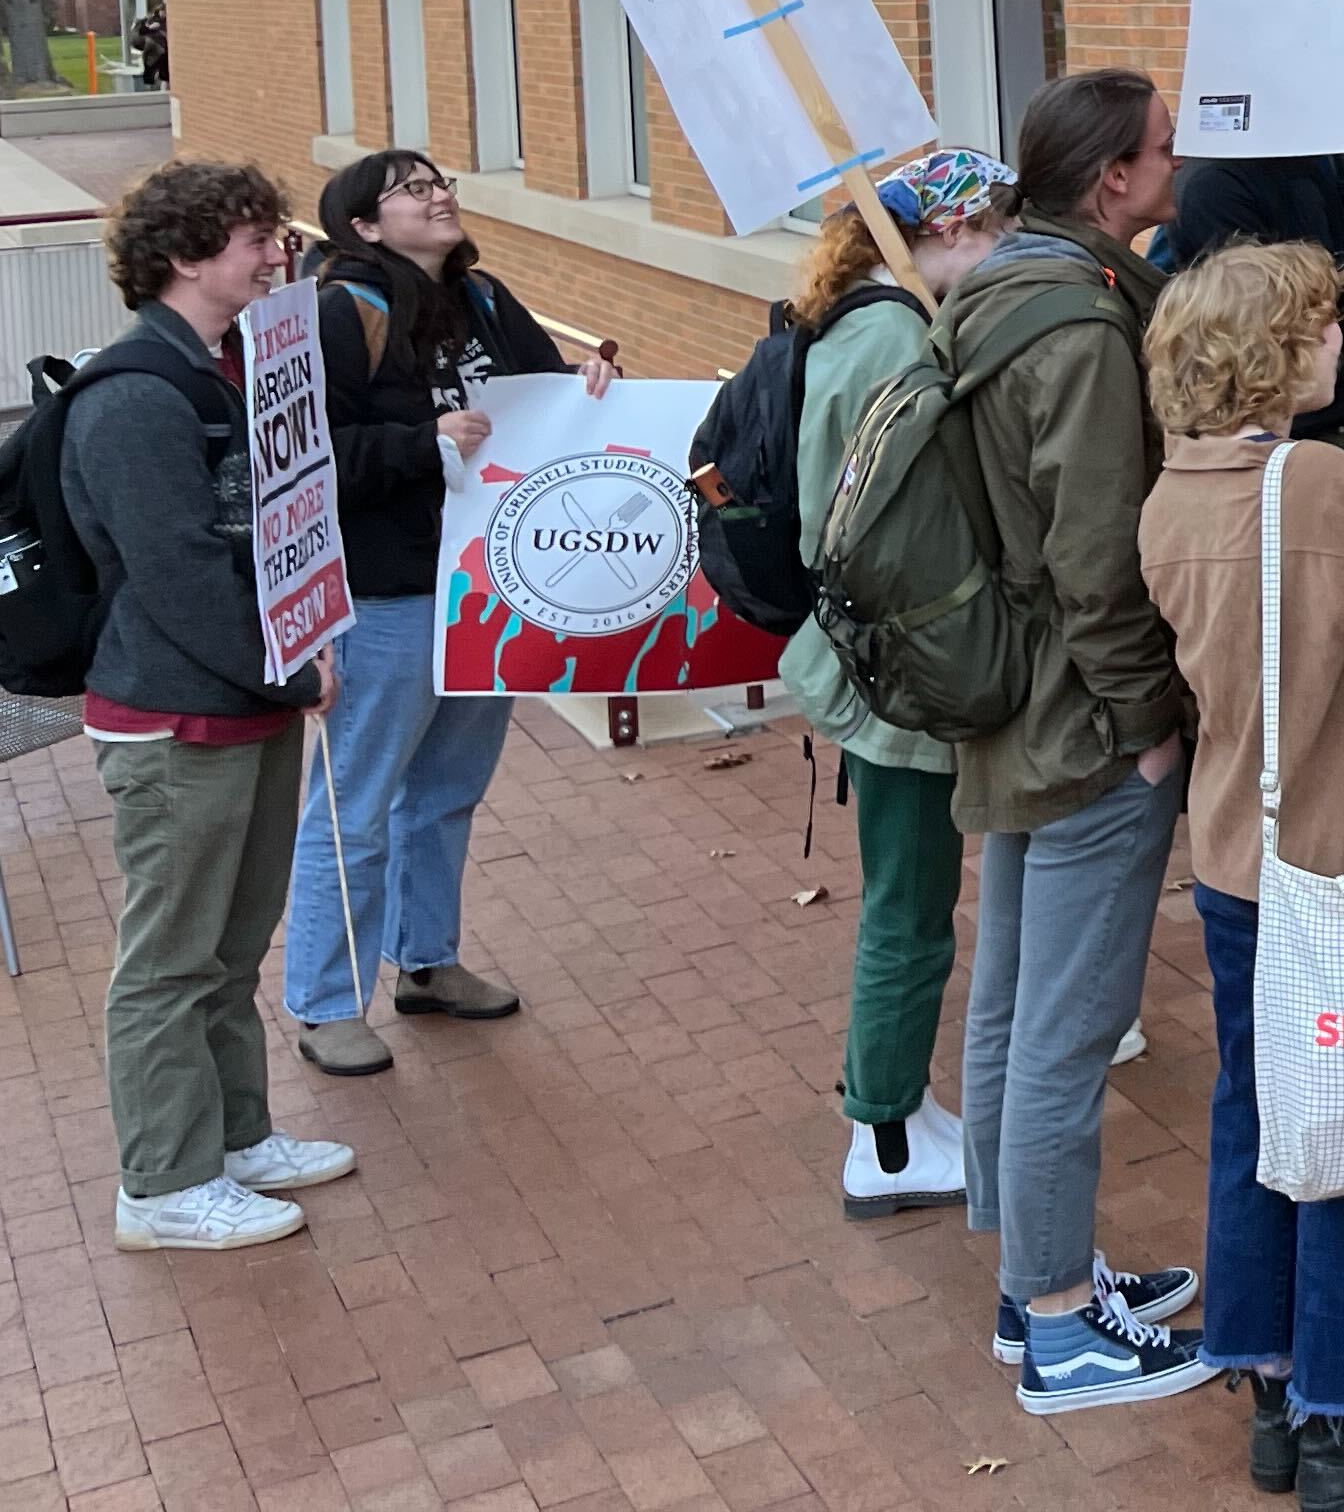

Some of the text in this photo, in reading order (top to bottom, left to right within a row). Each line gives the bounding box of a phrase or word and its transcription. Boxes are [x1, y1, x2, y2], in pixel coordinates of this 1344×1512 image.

[253, 351, 312, 418] ARGAIN
[580, 458, 661, 480] STUDENT
[505, 464, 576, 518] GRINNELL
[263, 511, 282, 551] NO
[495, 521, 511, 541] OF
[533, 528, 665, 555] UGSDW
[494, 546, 519, 594] UNION
[537, 607, 636, 629] EST 2016
